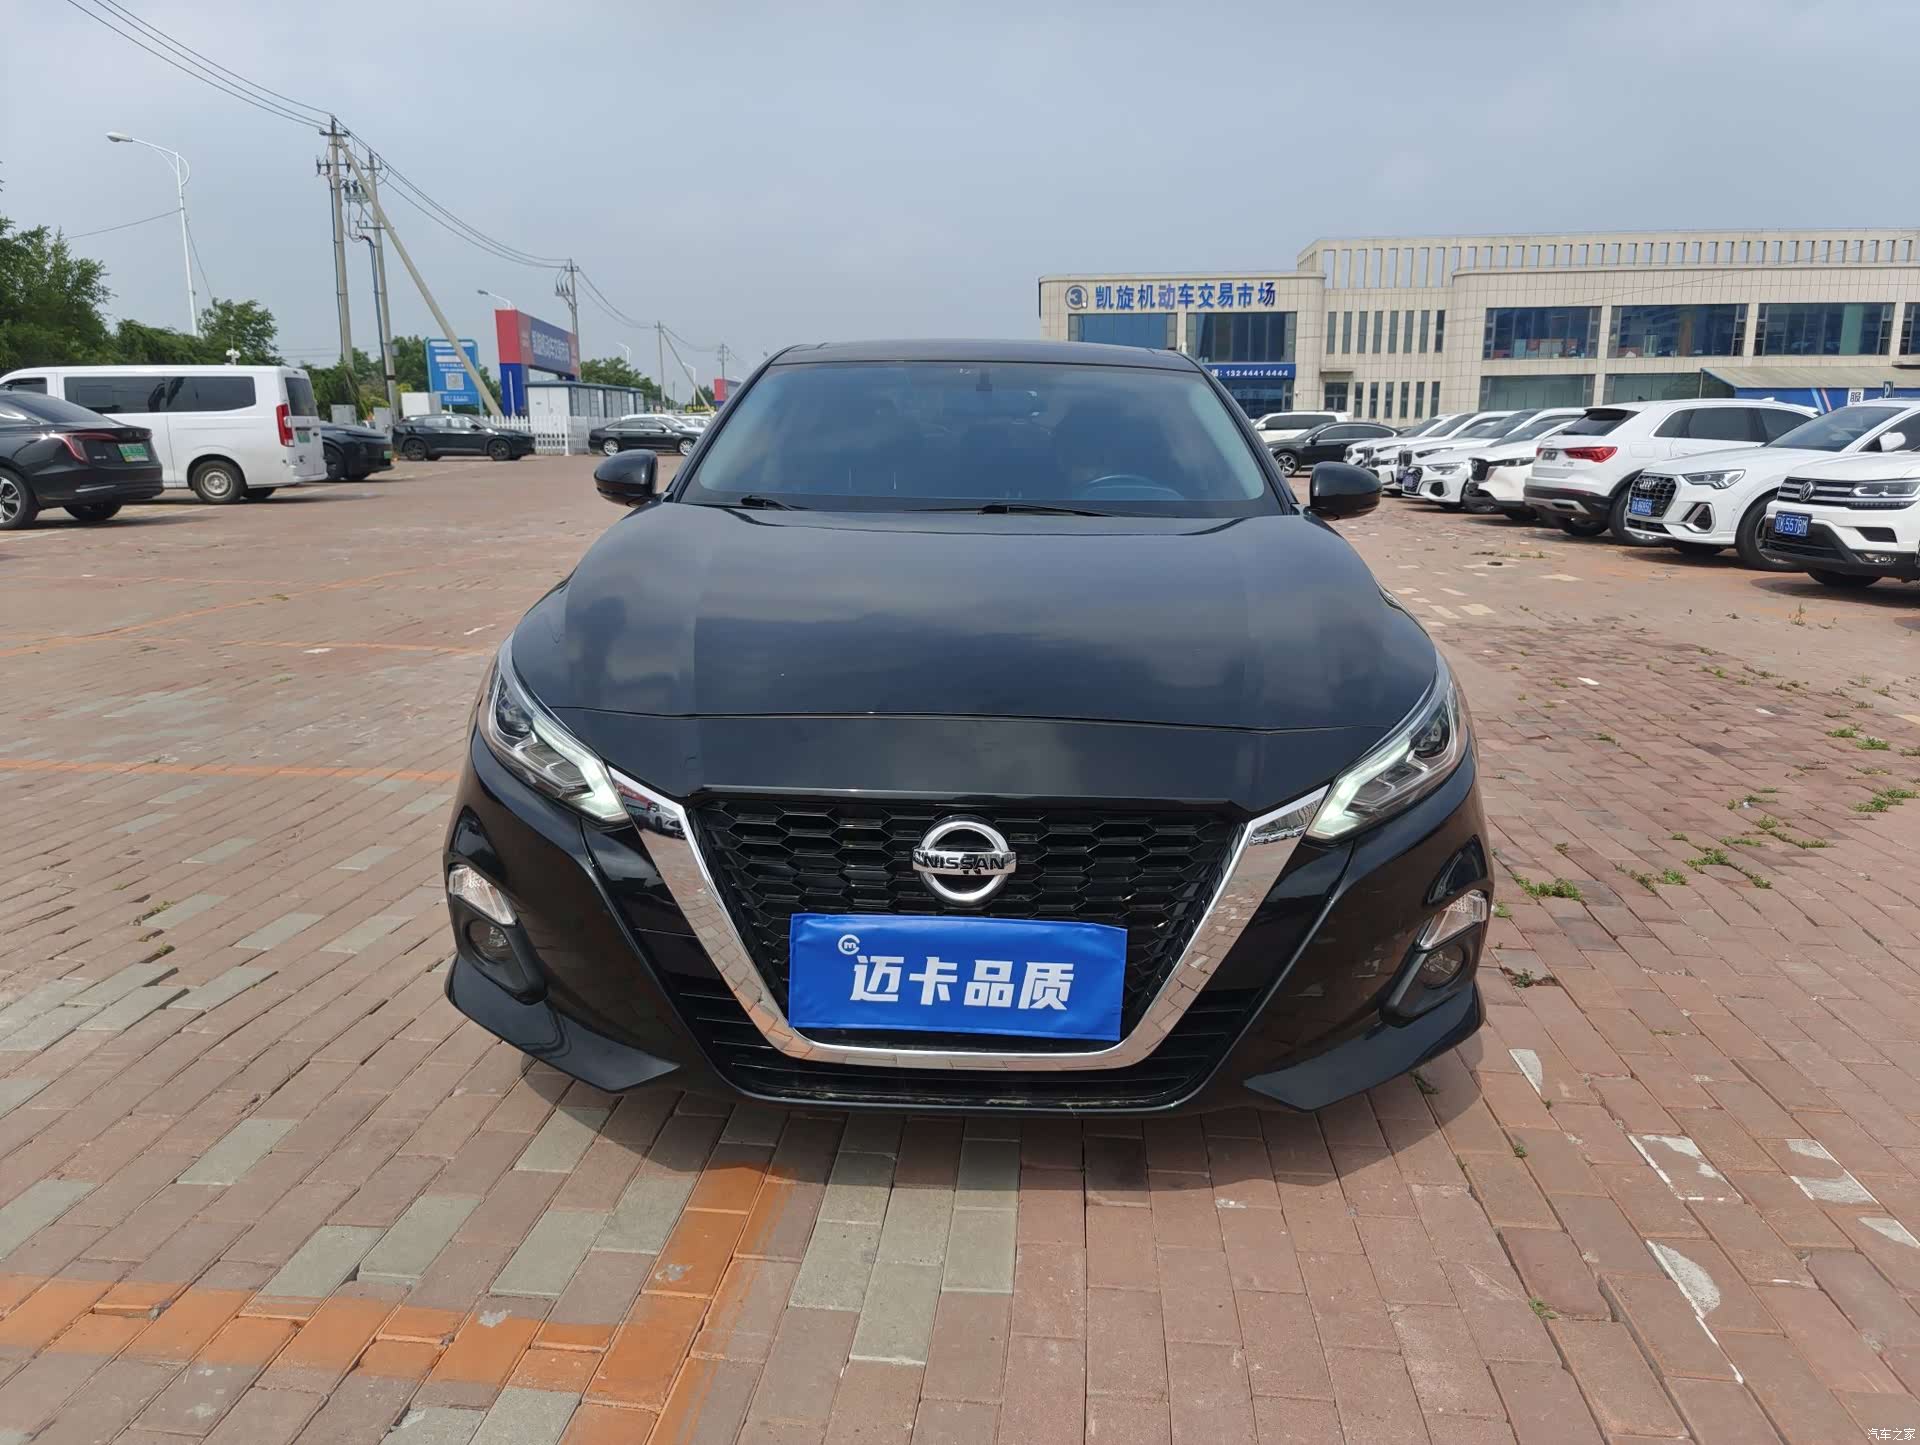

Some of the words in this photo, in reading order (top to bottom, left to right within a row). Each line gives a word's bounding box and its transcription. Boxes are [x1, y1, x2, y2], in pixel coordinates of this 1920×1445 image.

[1095, 281, 1276, 311] 凯旋机动车交易市场
[923, 853, 1005, 870] NISSAN
[849, 954, 1075, 1011] 迈卡品质
